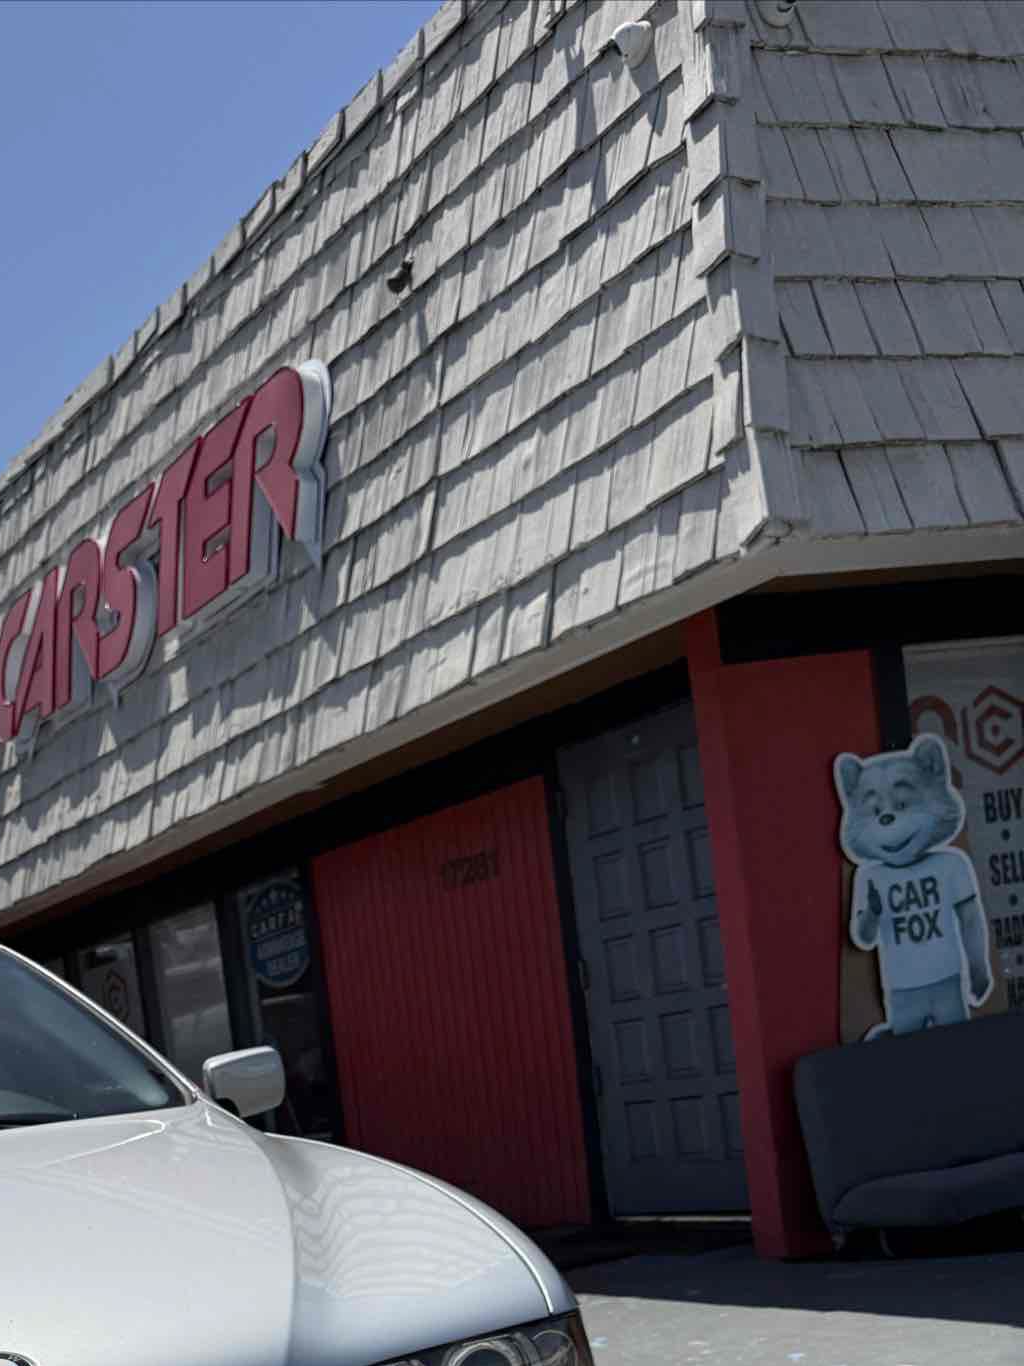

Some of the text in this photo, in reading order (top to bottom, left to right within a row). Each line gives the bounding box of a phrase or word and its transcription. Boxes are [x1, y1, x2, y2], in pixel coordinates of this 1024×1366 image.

[983, 787, 1024, 824] BUY
[888, 876, 941, 914] CAR
[893, 910, 943, 944] FOX
